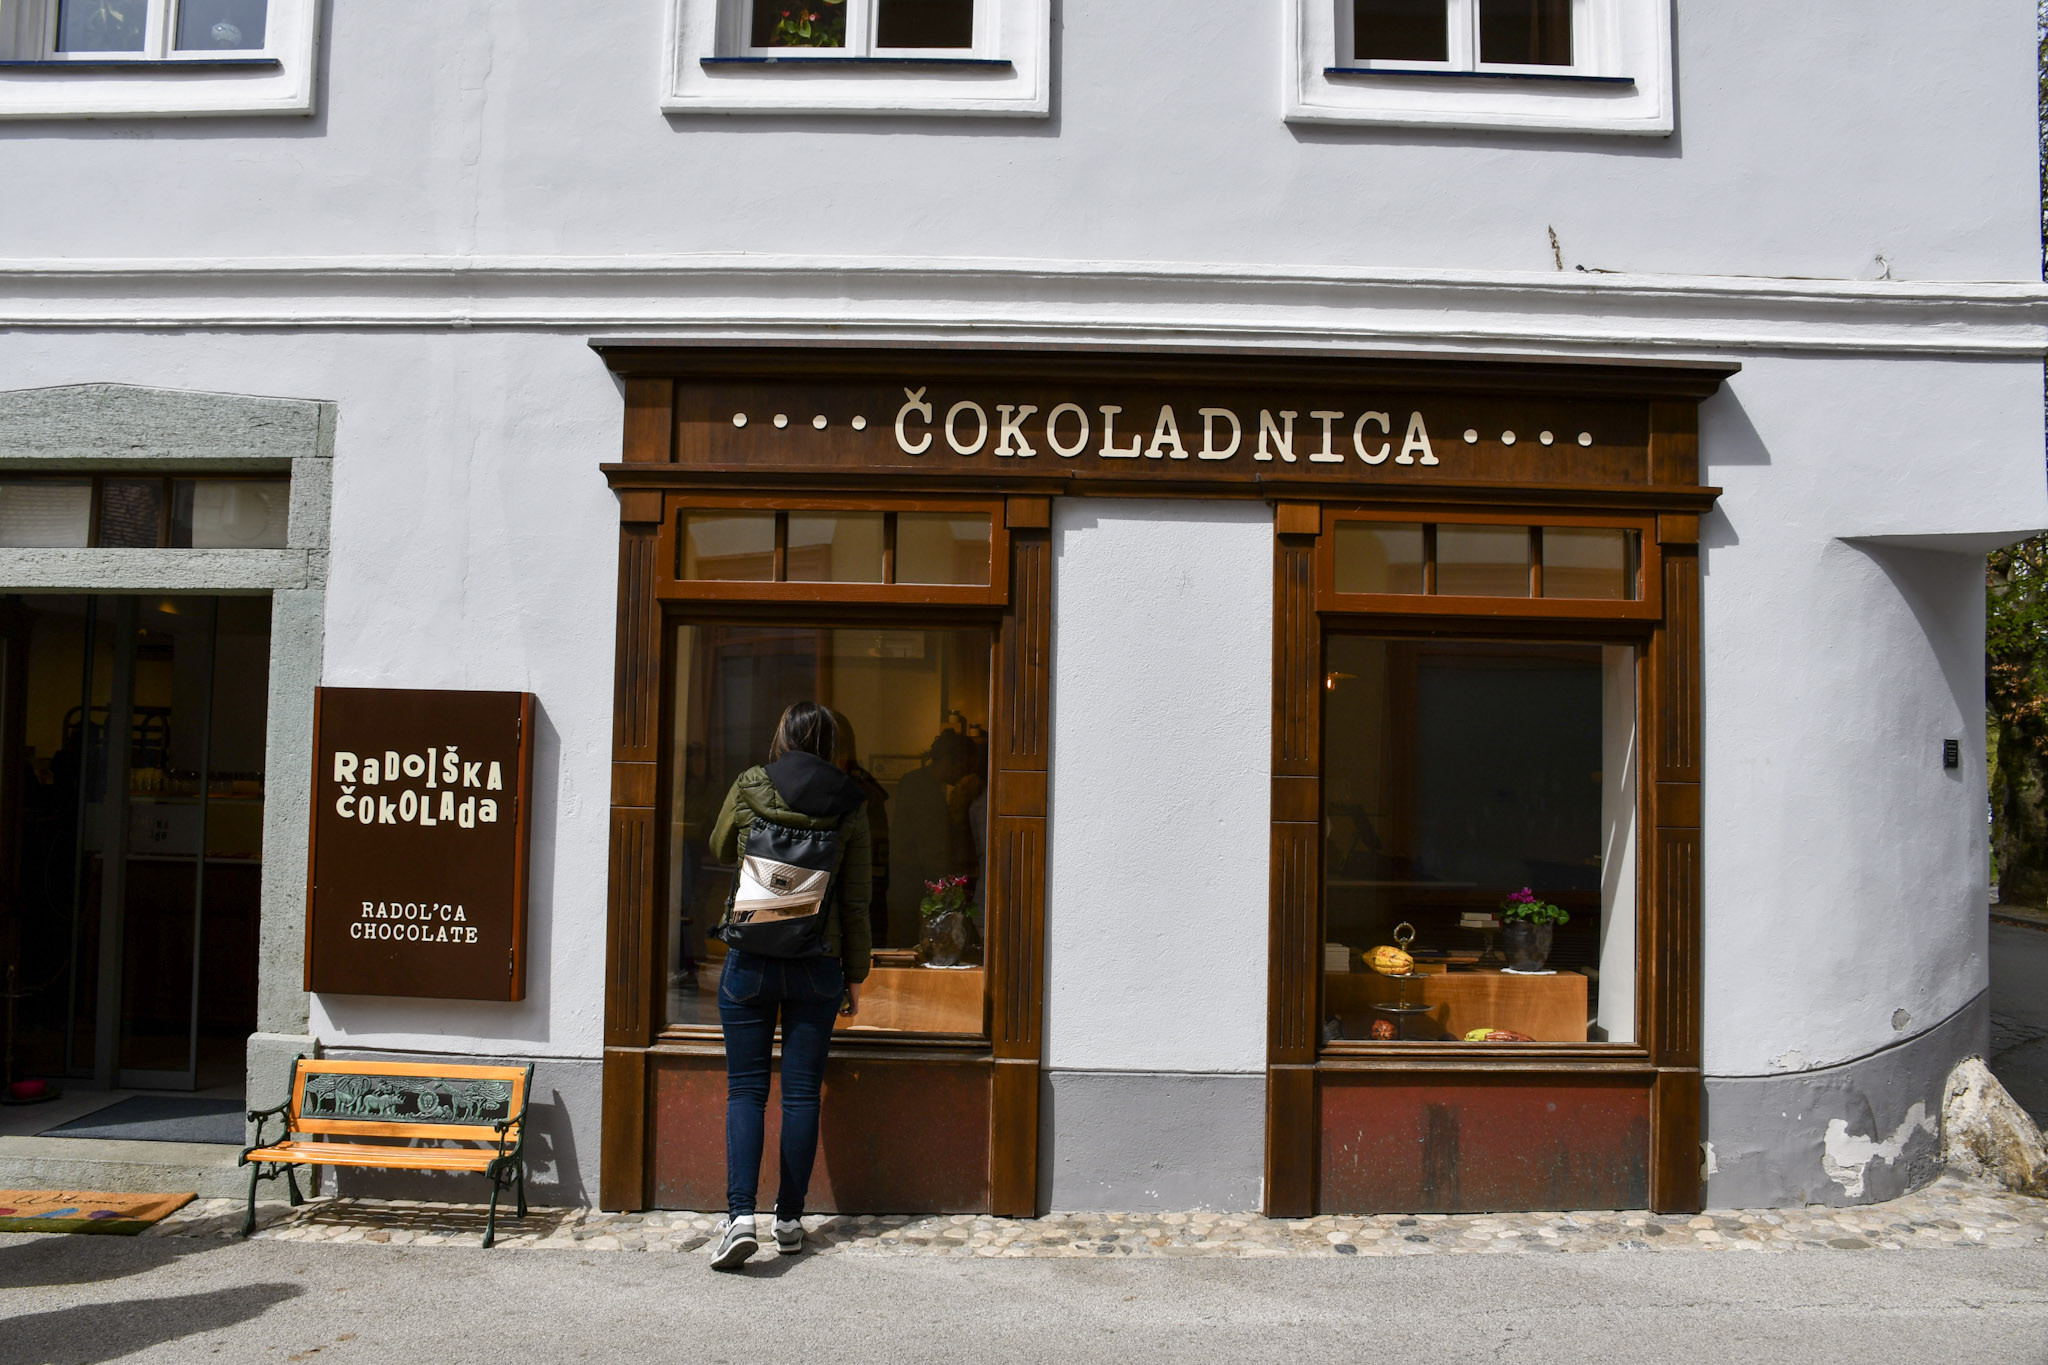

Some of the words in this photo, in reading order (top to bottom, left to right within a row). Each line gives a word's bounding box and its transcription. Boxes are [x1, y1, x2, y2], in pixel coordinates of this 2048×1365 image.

[894, 386, 1440, 466] ČOKOLADNICA
[361, 901, 467, 922] RADOL'CA
[350, 922, 478, 944] CHOCOLATE
